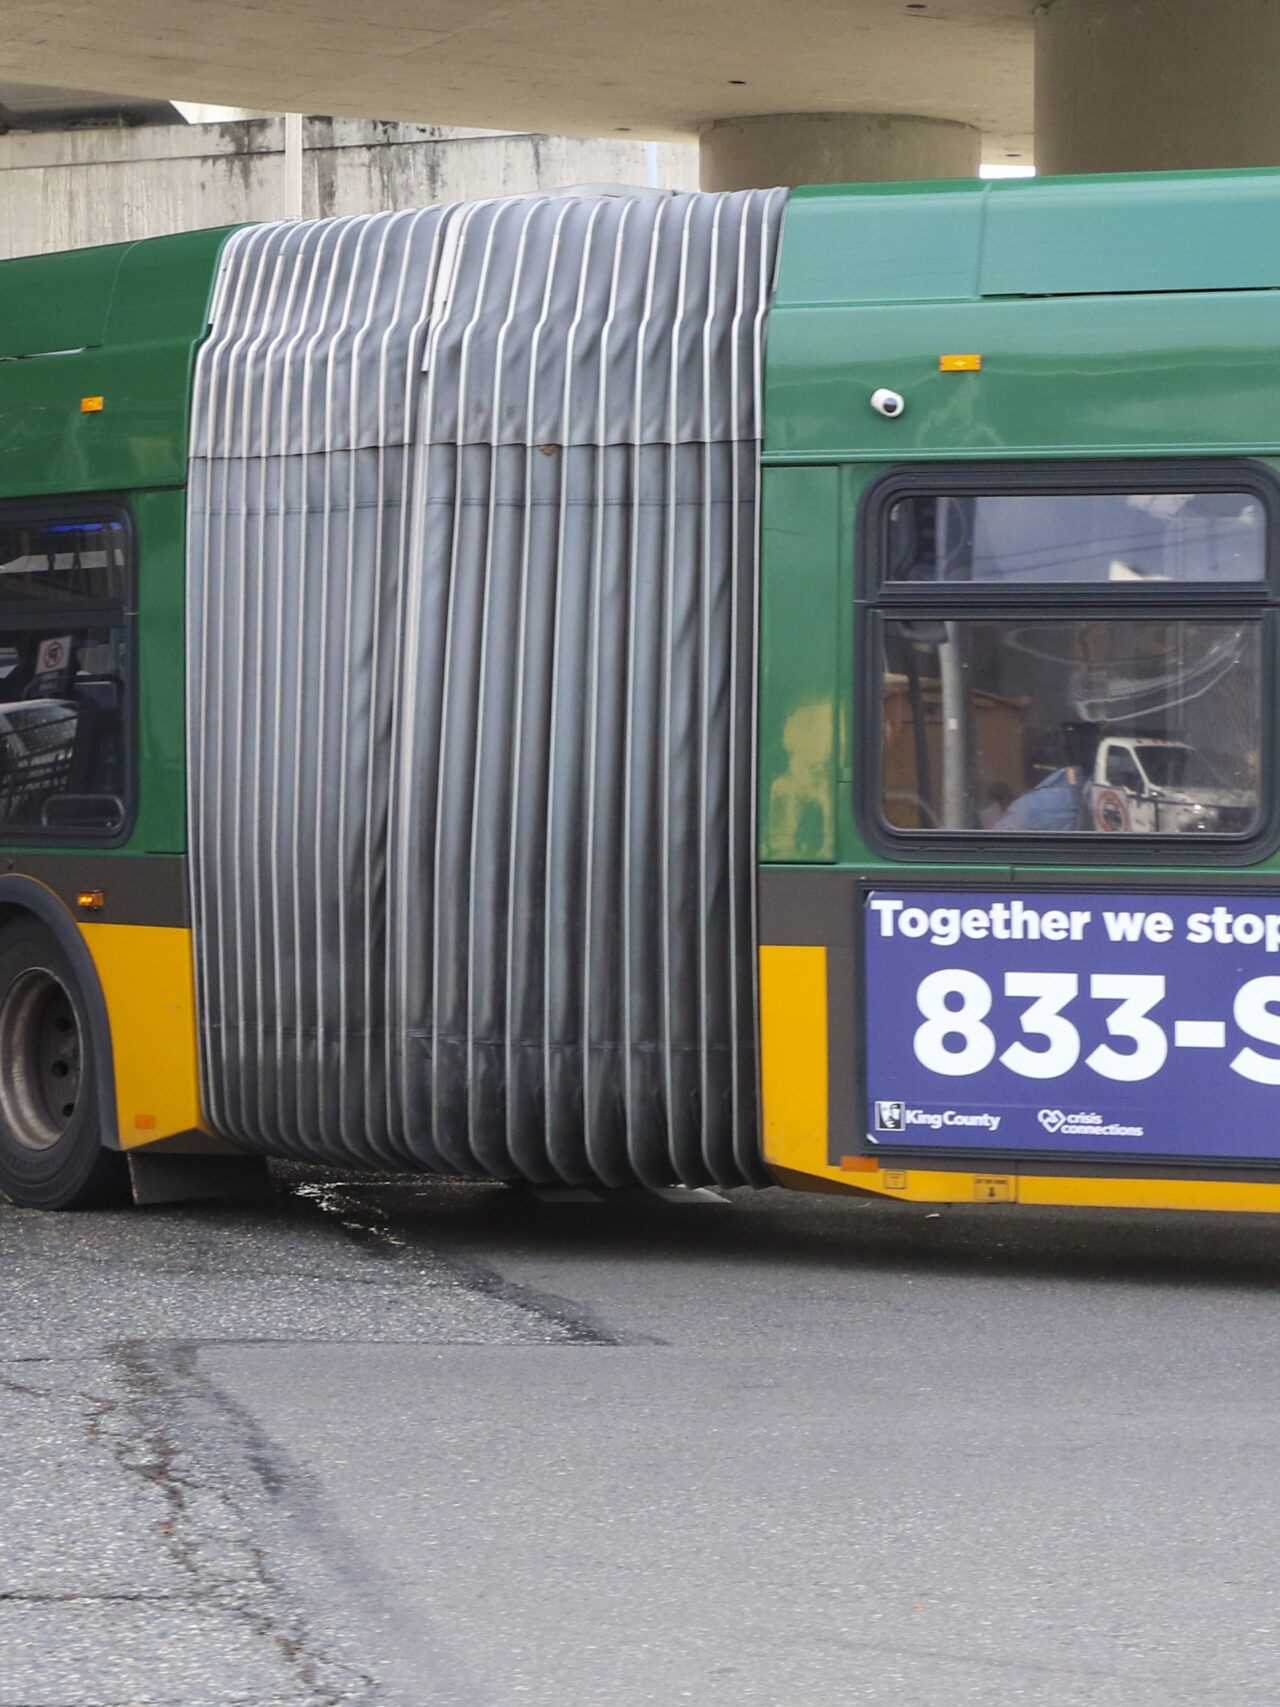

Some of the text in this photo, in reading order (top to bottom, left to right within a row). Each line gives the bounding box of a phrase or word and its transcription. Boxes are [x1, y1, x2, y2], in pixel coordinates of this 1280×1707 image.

[871, 899, 1092, 946] Together
[1102, 911, 1174, 943] we
[905, 1109, 1001, 1131] King County
[1066, 1111, 1103, 1125] crisis
[1060, 1123, 1144, 1136] connections
